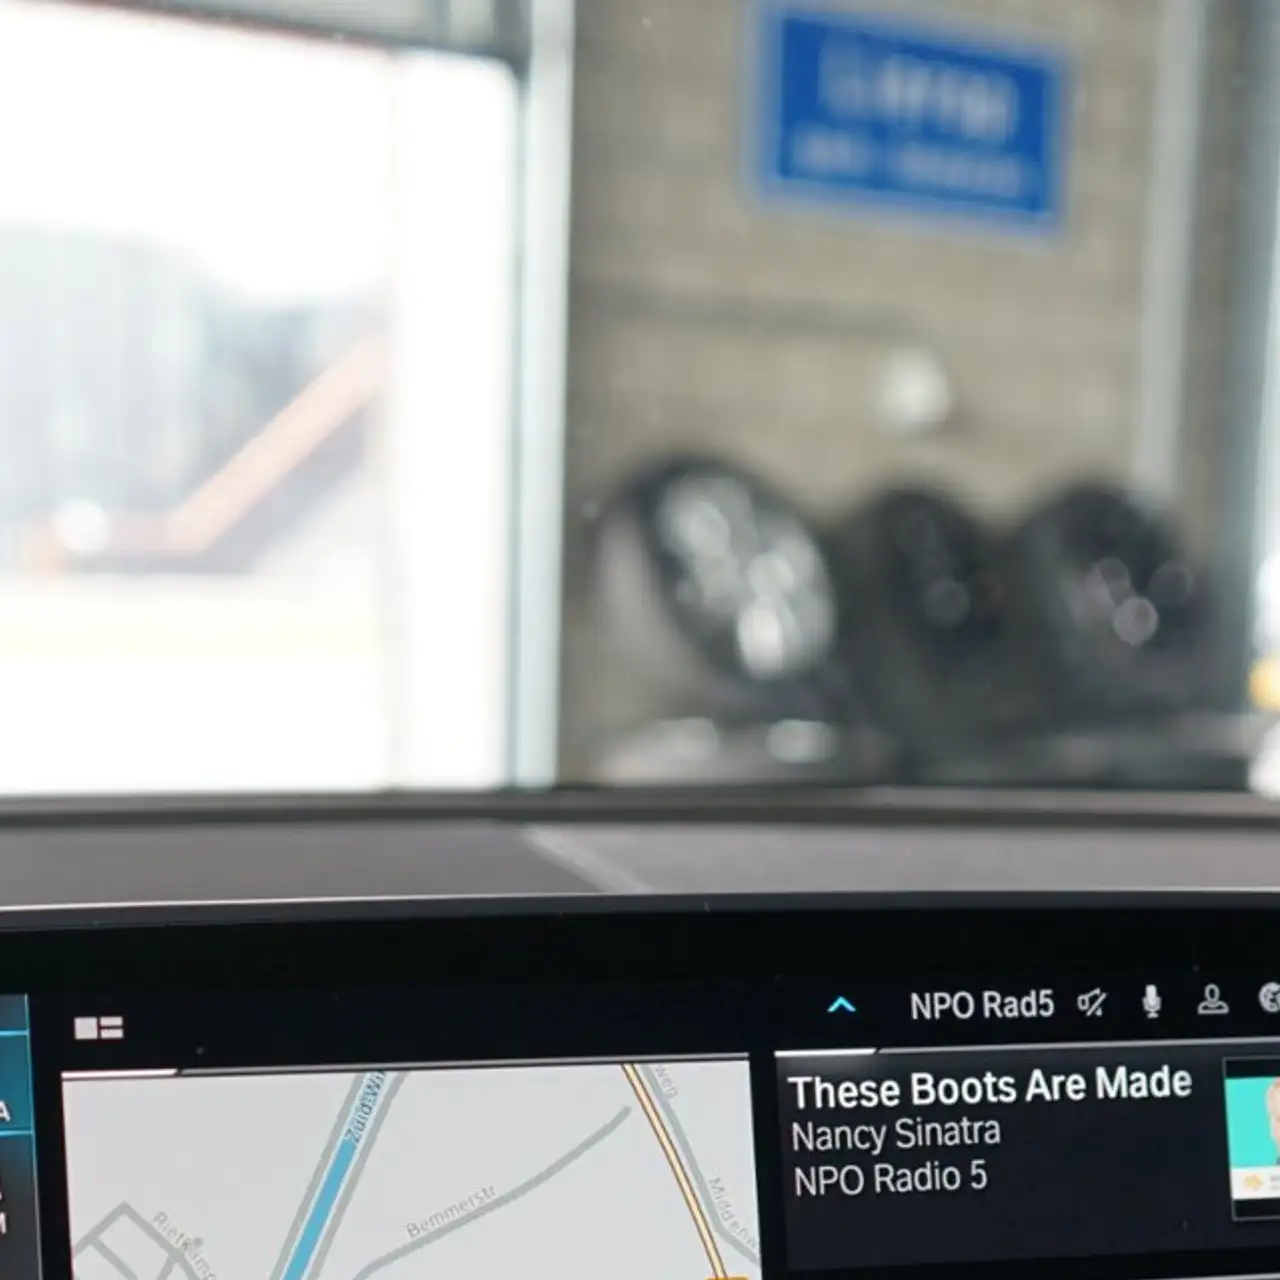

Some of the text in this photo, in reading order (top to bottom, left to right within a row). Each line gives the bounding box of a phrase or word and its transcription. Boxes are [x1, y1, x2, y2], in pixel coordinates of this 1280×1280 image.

[911, 989, 1054, 1019] NPO Rad5
[787, 1065, 1191, 1109] These Boots Are Made
[793, 1117, 1000, 1155] Nancy Sinatra
[795, 1160, 987, 1196] NPO Radio 5
